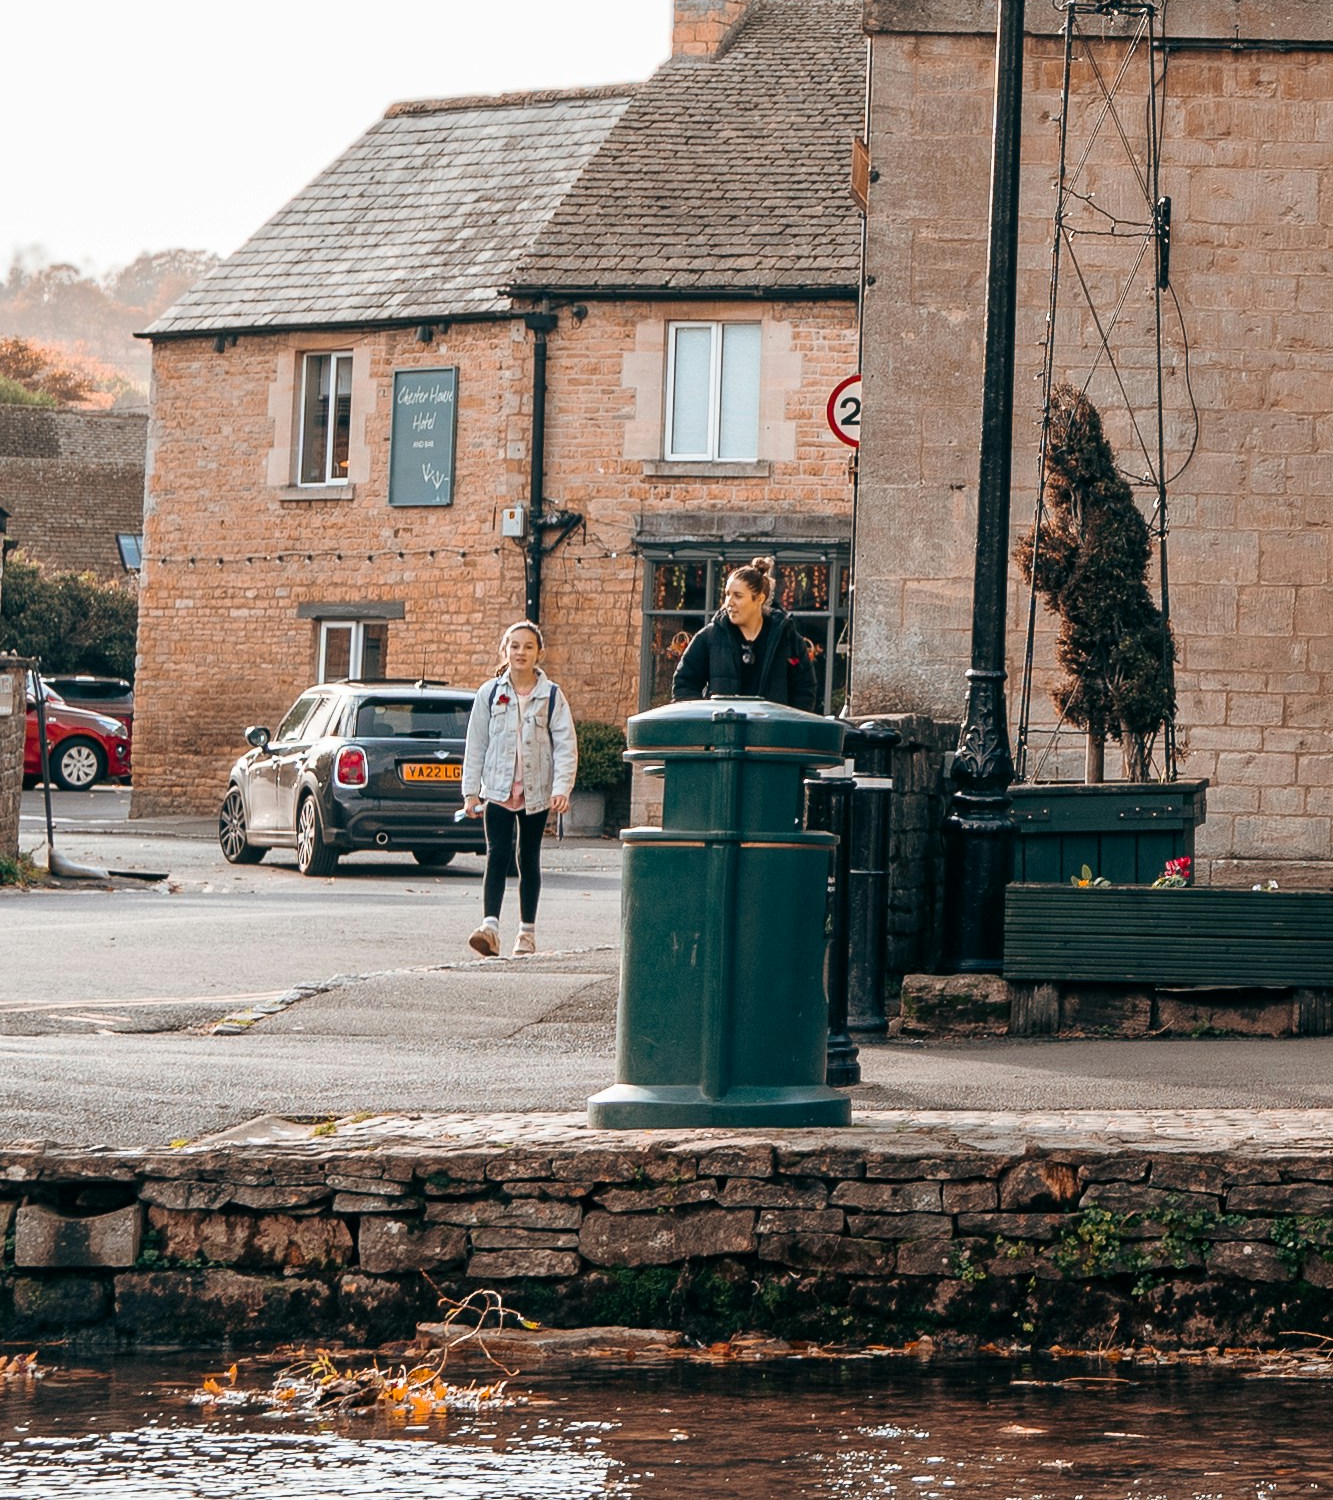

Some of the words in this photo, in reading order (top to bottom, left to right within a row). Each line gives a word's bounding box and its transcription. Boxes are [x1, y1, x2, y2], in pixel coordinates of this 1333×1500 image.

[397, 386, 429, 406] Chester
[840, 397, 861, 425] 2
[412, 412, 437, 432] Hotel
[409, 766, 442, 778] YA22
[444, 766, 463, 779] LG
